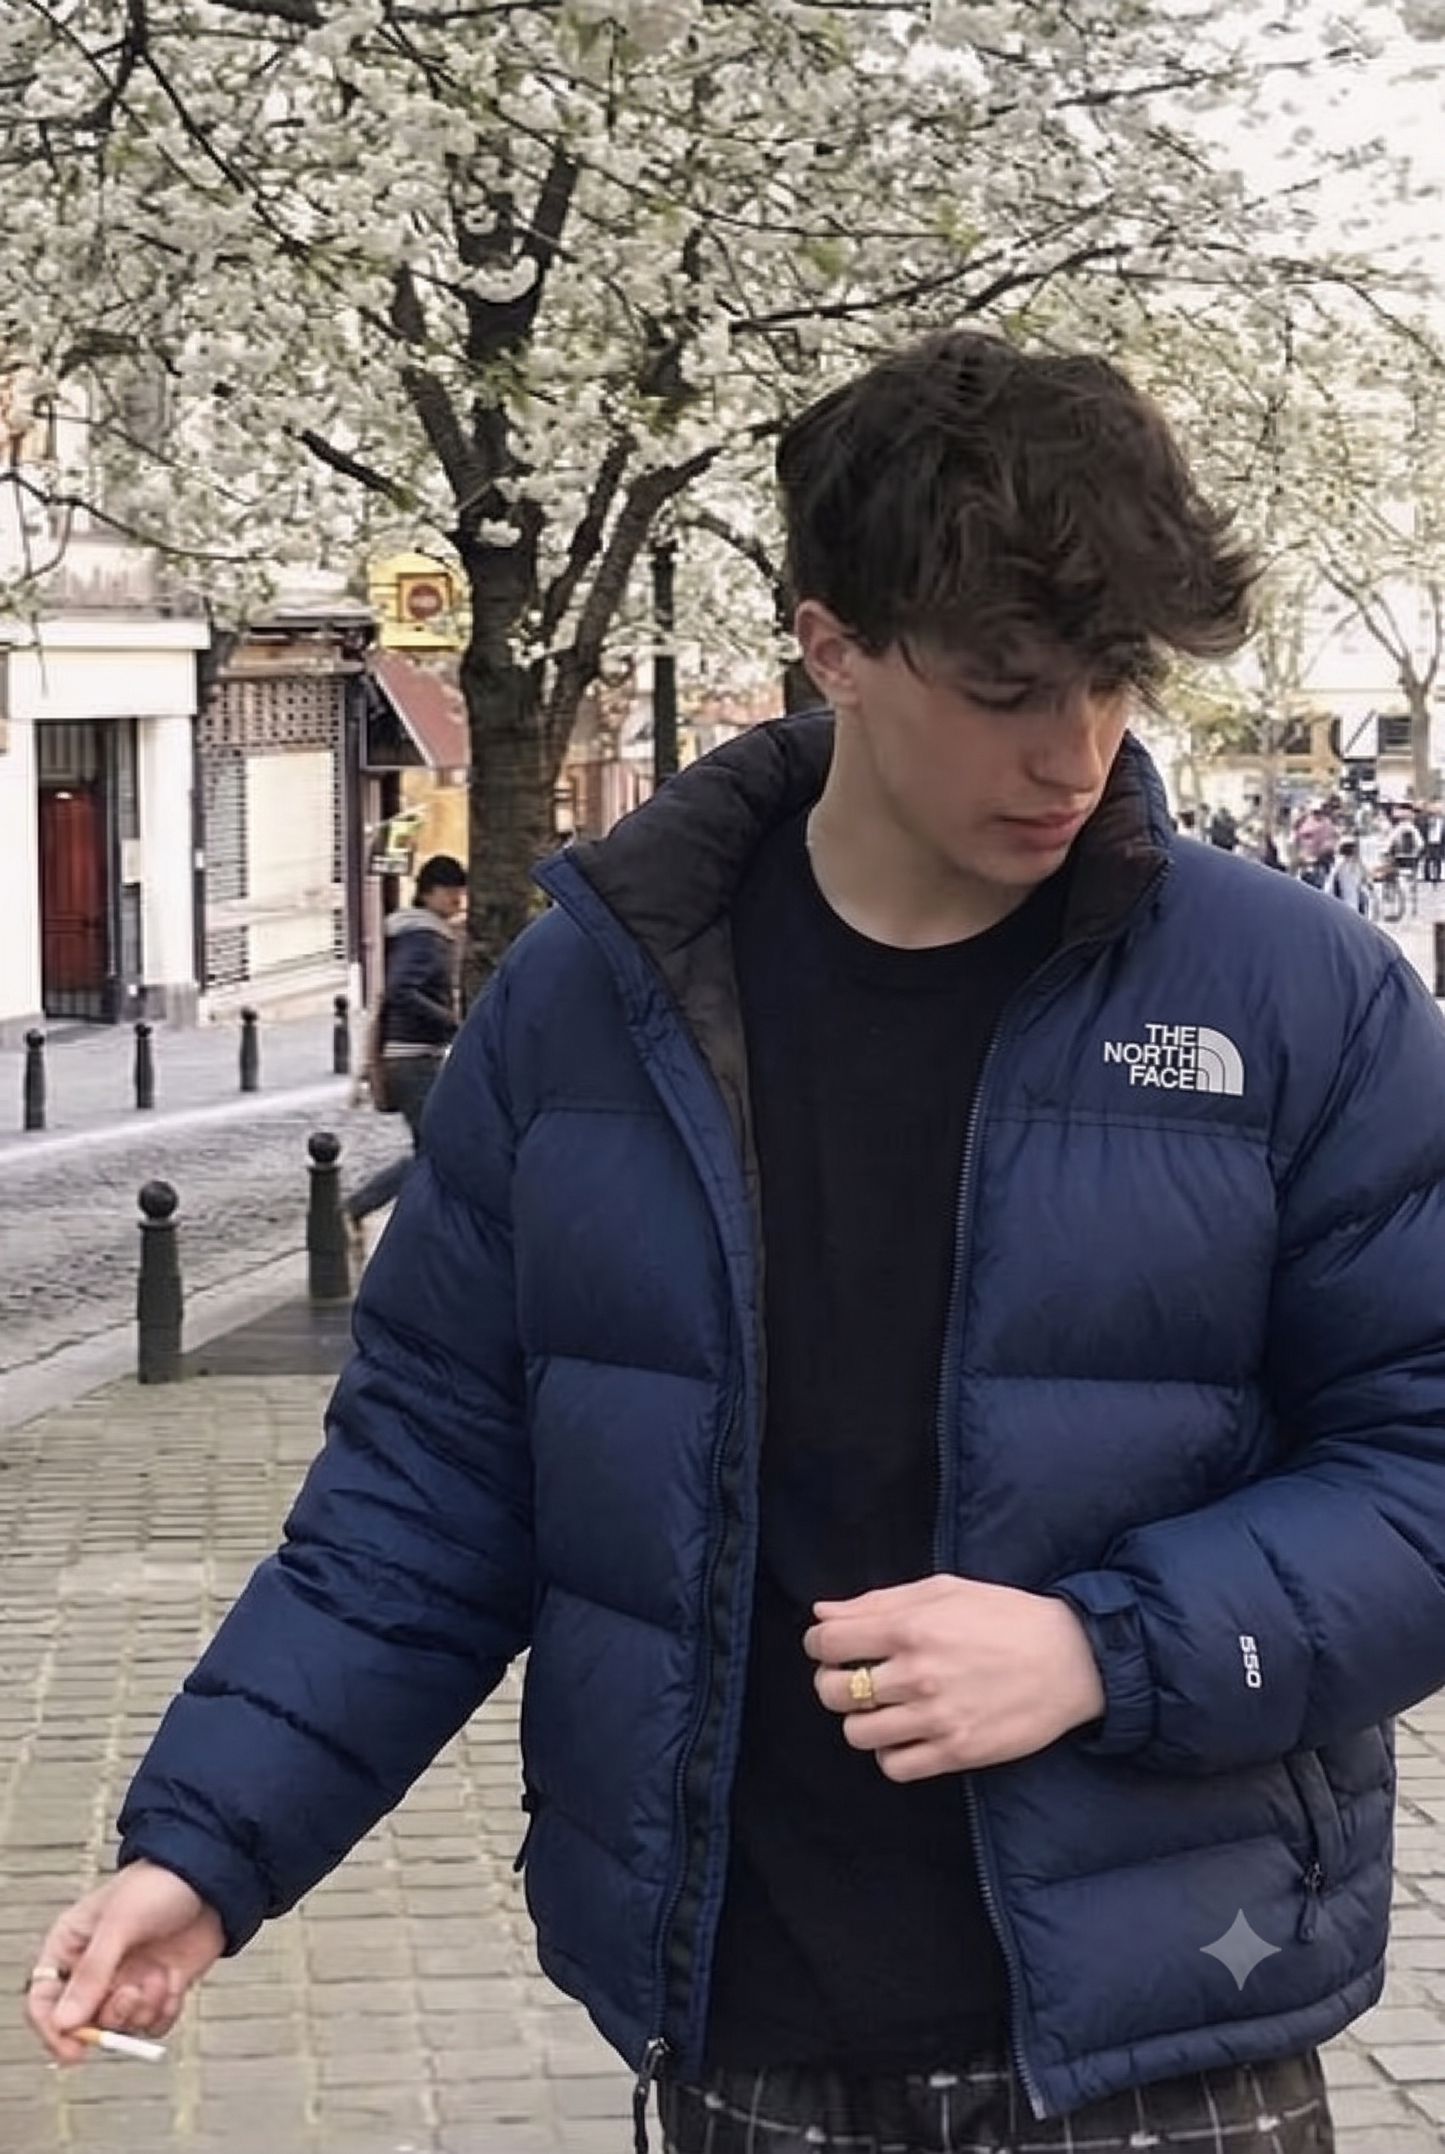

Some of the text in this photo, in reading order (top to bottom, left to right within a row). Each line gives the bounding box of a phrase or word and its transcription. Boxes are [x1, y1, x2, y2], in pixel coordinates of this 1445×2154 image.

[1145, 1023, 1197, 1046] THE
[1103, 1041, 1196, 1068] NORTH
[1129, 1065, 1196, 1090] FACE
